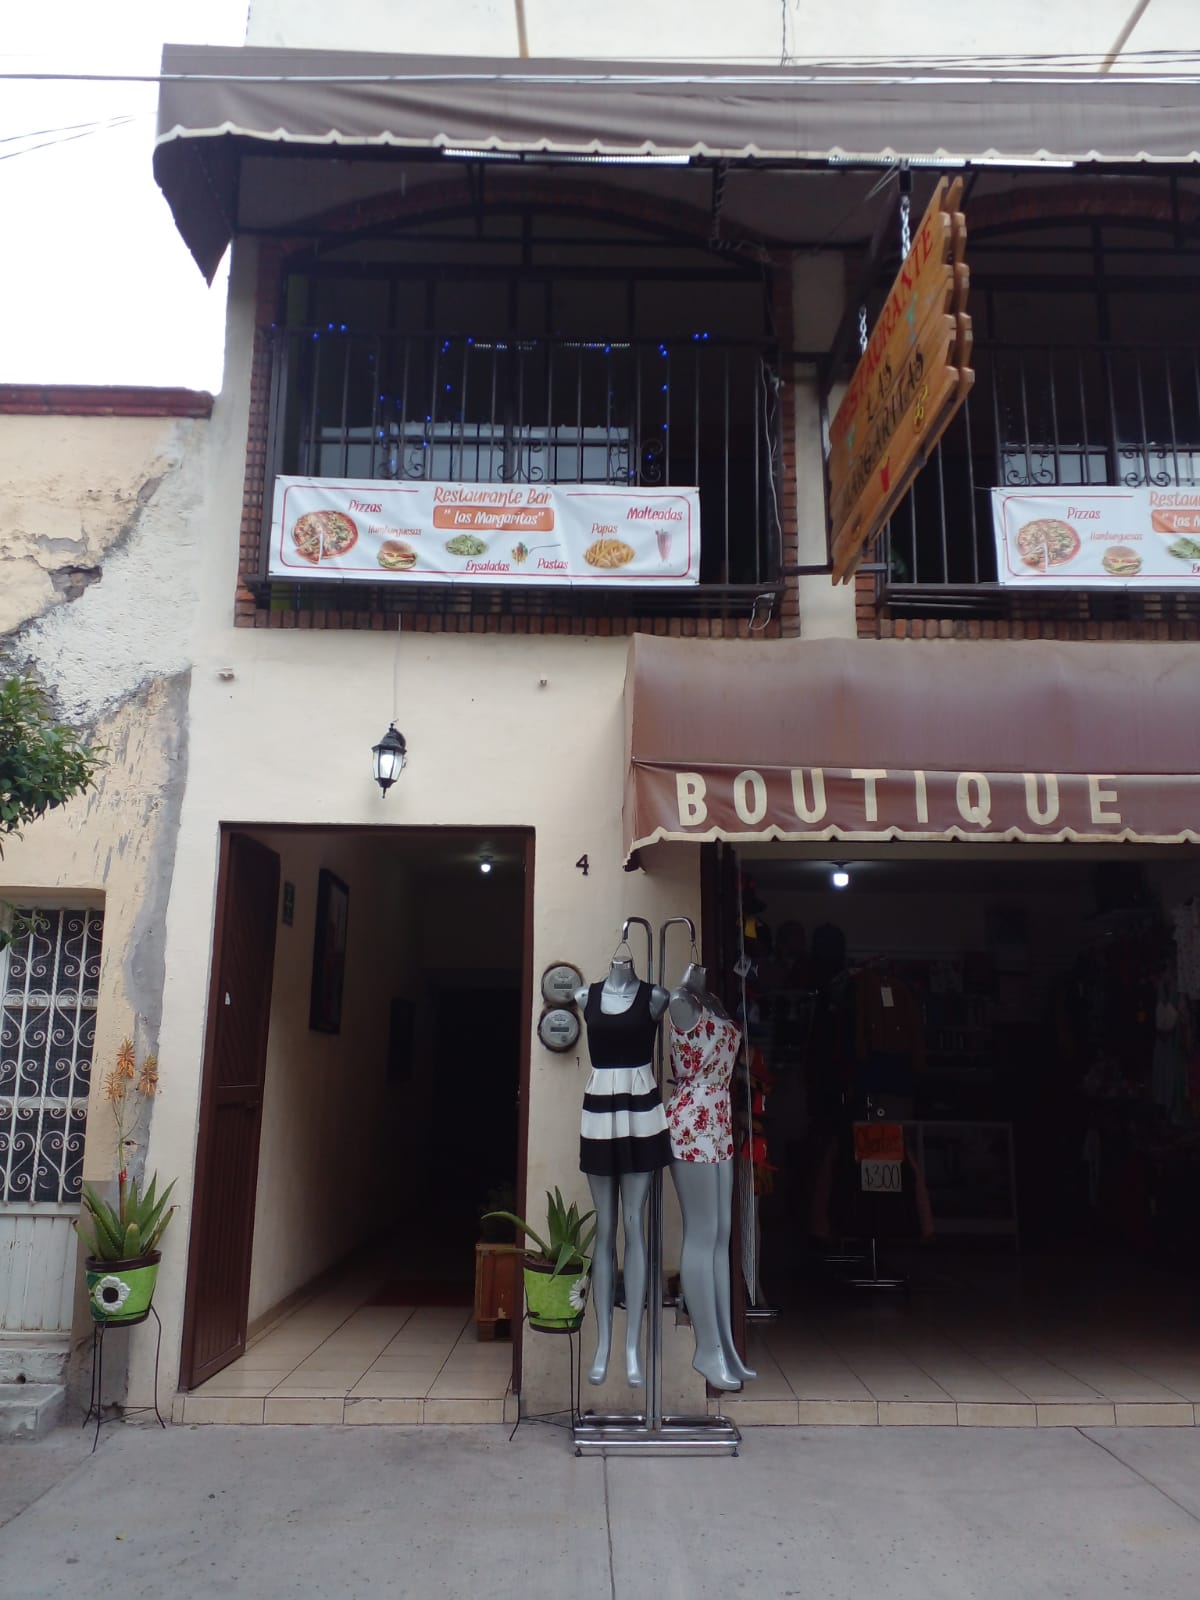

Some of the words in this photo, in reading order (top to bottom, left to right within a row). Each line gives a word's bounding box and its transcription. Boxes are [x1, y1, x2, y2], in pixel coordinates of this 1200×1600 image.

[833, 215, 933, 438] RESTAURANTE
[867, 357, 892, 424] LAS
[433, 486, 522, 507] Restaurante
[527, 488, 552, 504] Bar
[349, 499, 382, 513] Pizzas
[627, 506, 682, 521] Malteadas
[1067, 506, 1100, 519] Pizzas
[591, 522, 618, 536] Papas
[465, 559, 510, 573] Ensaladas
[537, 558, 568, 570] Pastas
[676, 767, 1122, 828] BOUTIQUE
[575, 854, 590, 876] 4
